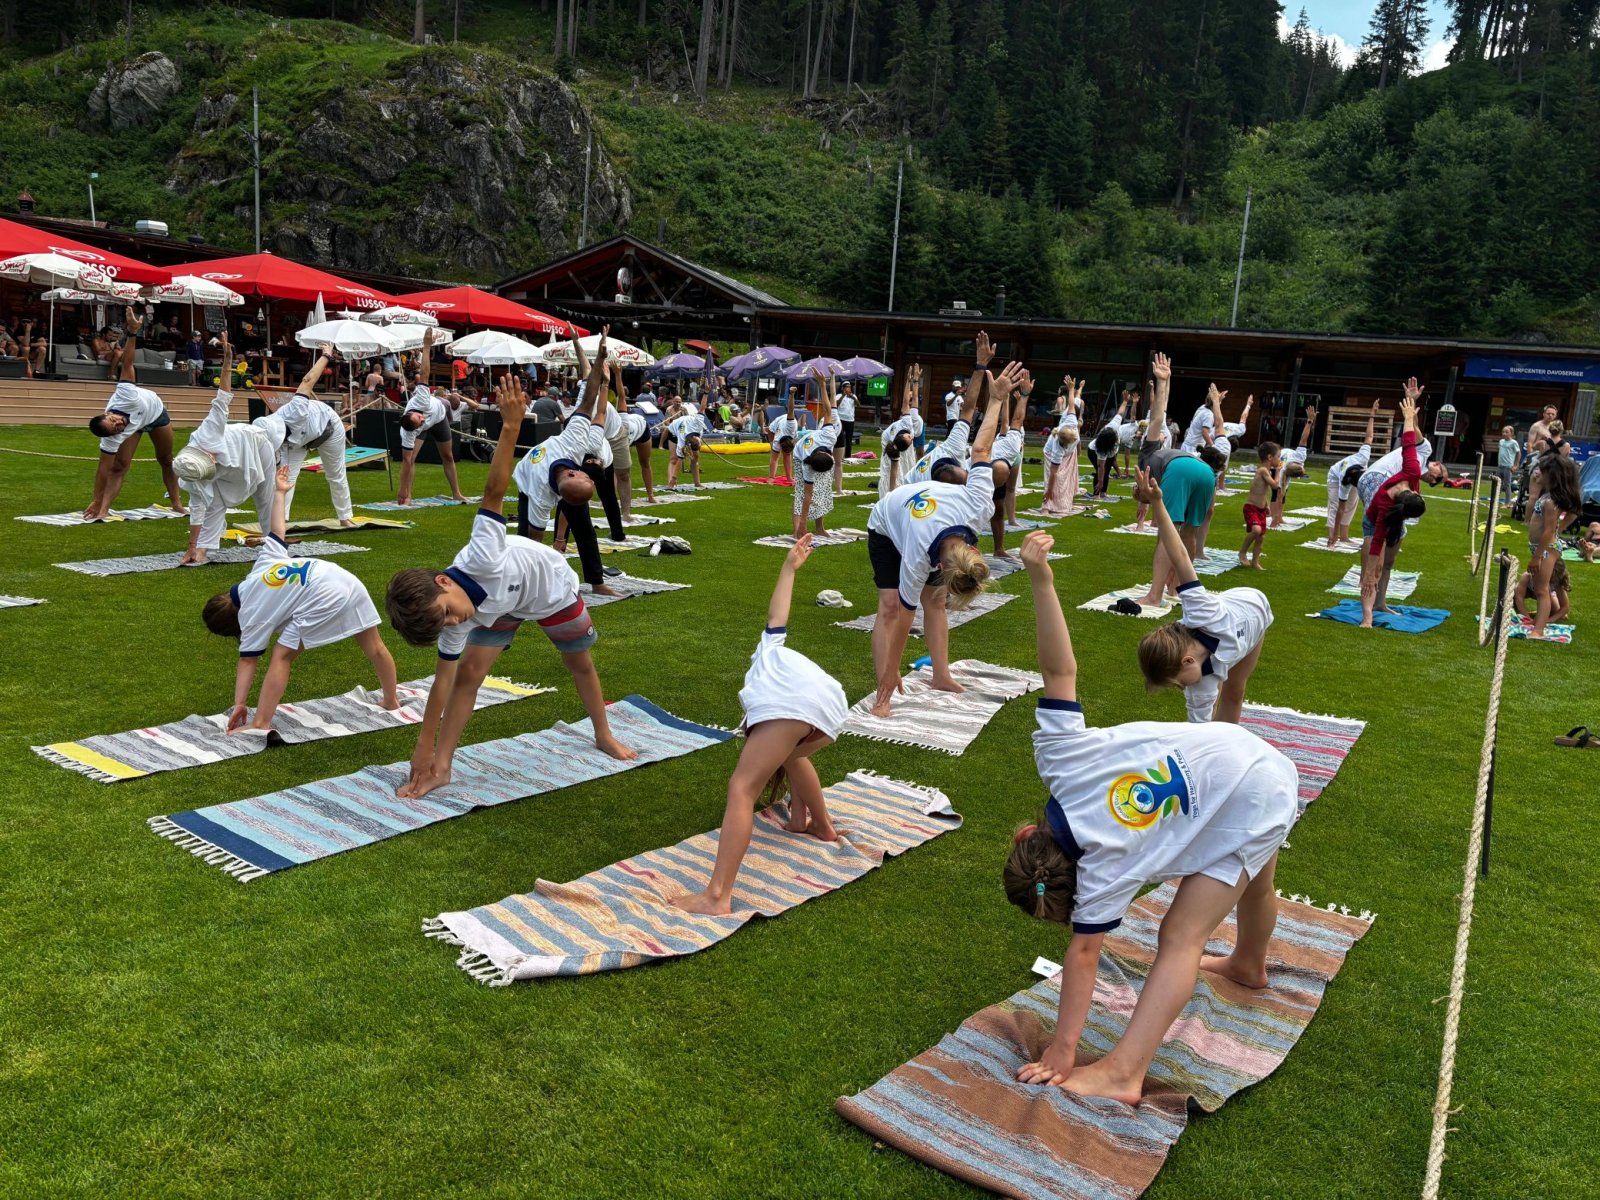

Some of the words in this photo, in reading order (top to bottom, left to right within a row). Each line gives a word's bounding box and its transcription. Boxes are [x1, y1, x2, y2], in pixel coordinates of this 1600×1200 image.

[356, 296, 386, 309] LUSSO
[1509, 367, 1546, 375] SURFCENTER
[1546, 369, 1584, 377] DAVOSERSEE
[1185, 770, 1195, 795] Harmony
